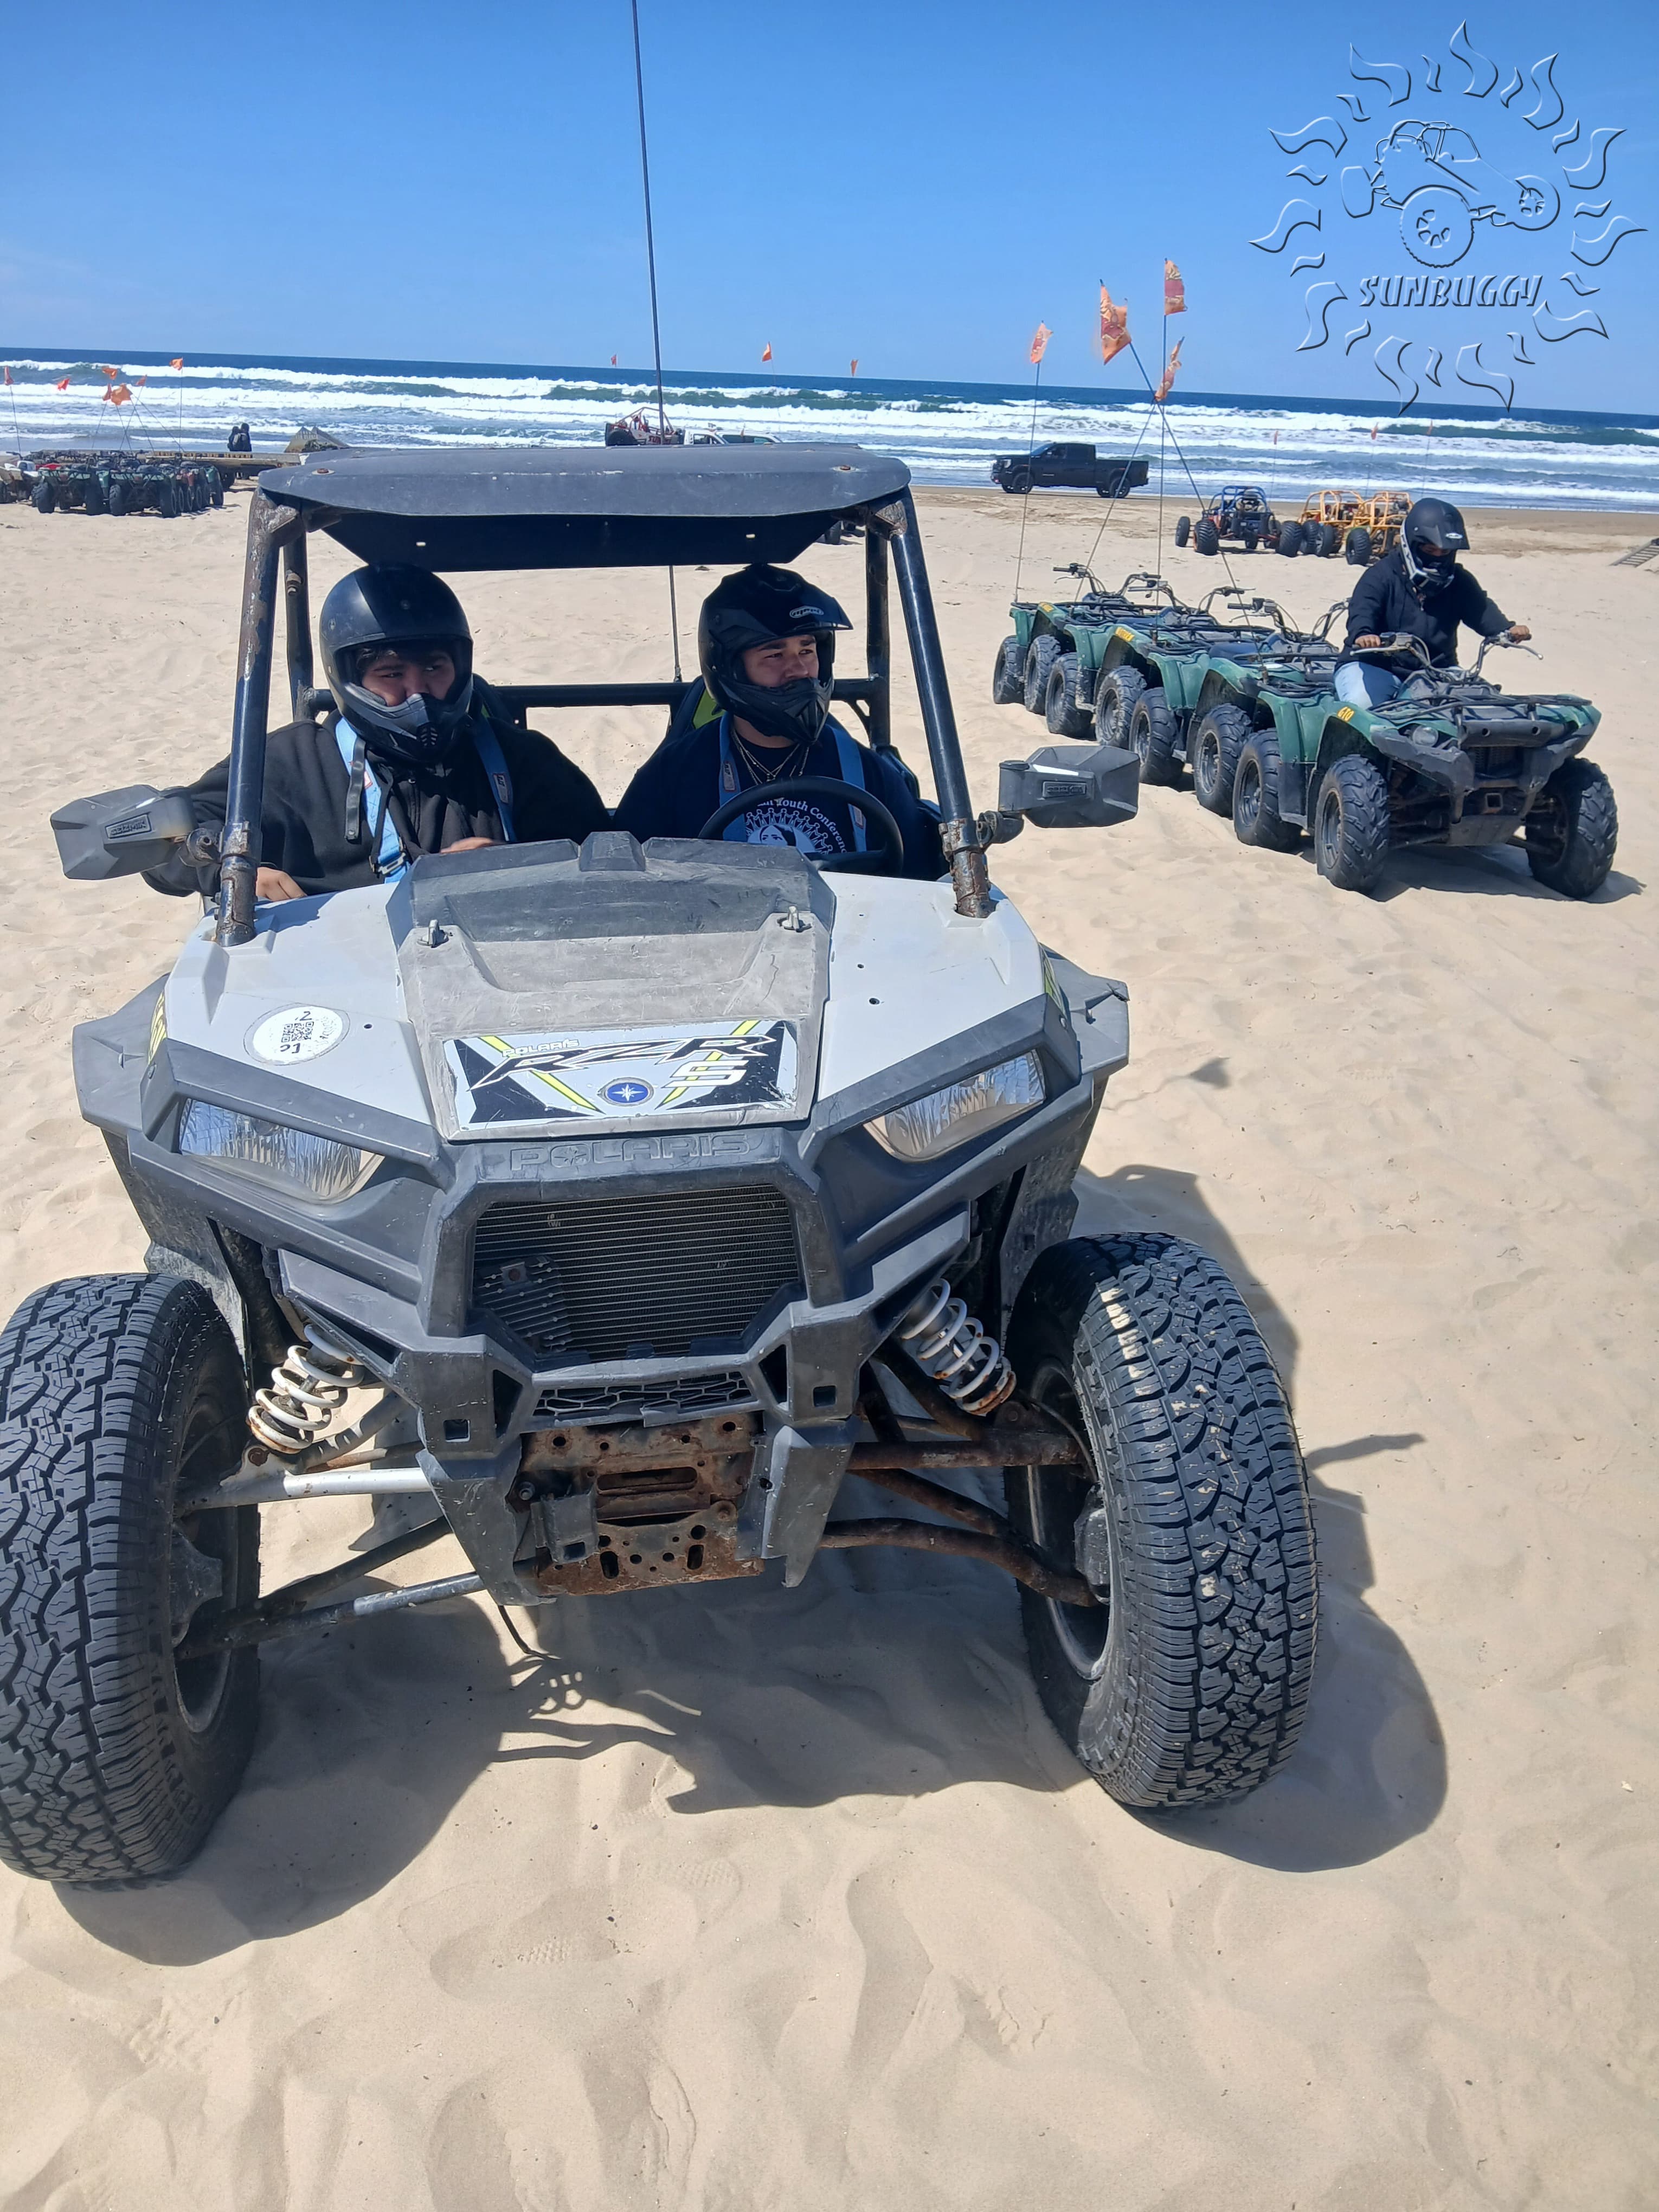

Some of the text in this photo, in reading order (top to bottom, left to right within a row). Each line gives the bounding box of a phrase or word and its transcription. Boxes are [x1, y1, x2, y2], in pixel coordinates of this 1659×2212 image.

[810, 807, 847, 853] Conferenc
[502, 1038, 580, 1057] POLARIS
[510, 1133, 751, 1172] POLARIS
